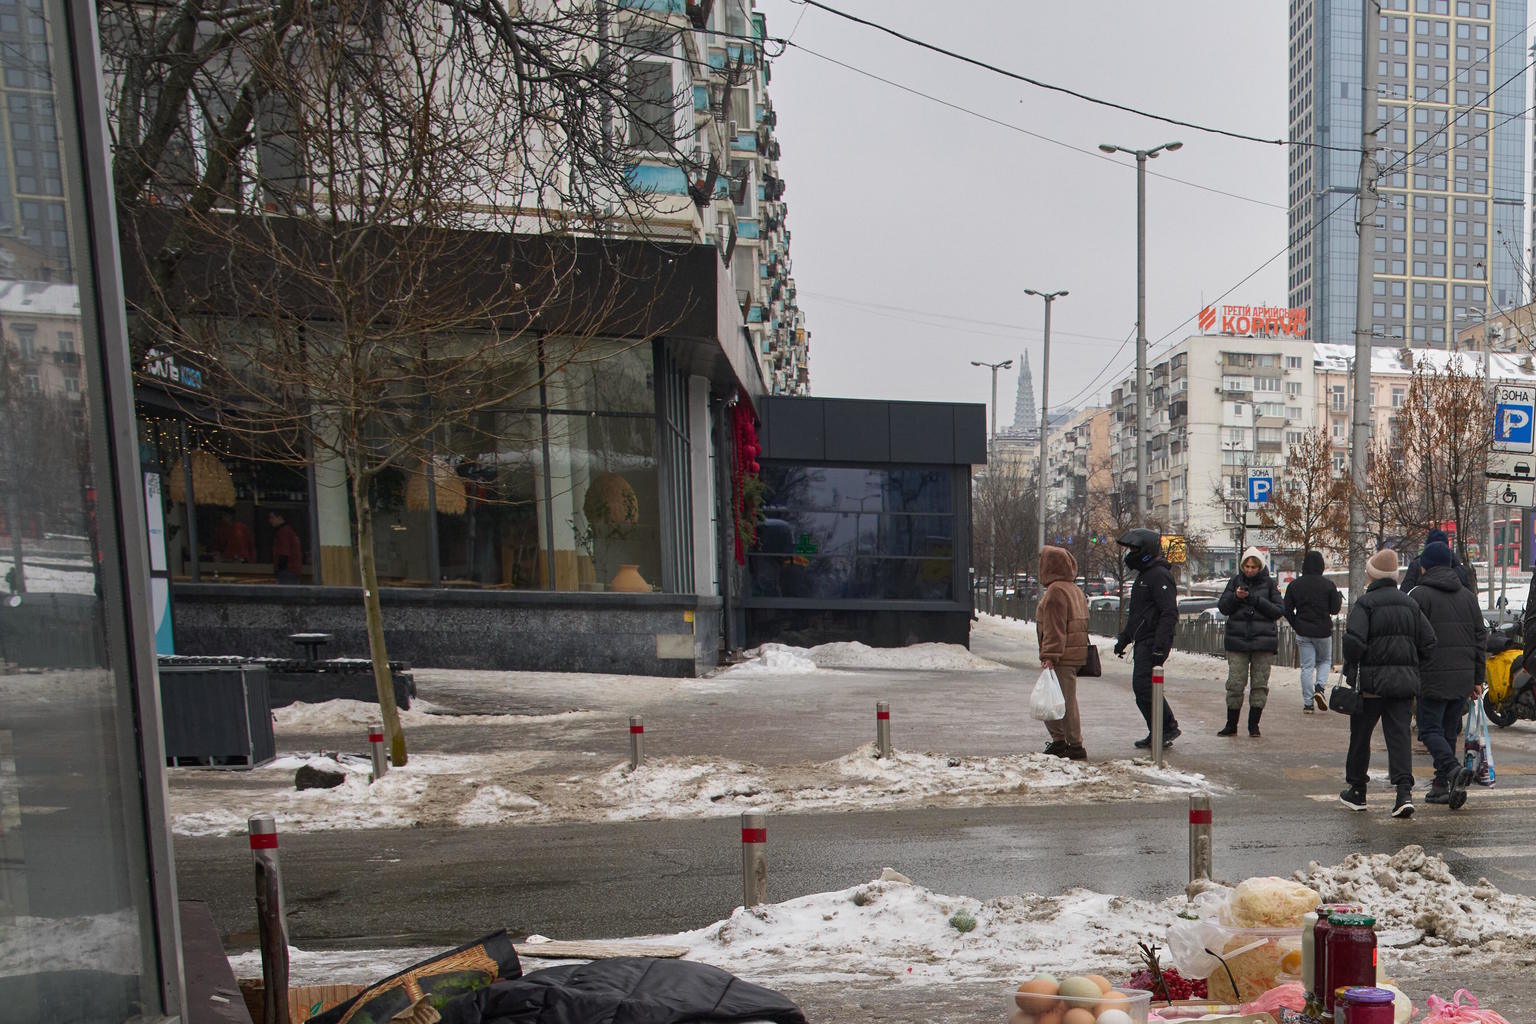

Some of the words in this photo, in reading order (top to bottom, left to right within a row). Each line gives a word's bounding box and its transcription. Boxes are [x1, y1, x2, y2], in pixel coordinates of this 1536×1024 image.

[1223, 304, 1251, 316] ТРЕТІЙ
[1222, 315, 1307, 336] КОРПУС
[1501, 389, 1529, 401] ЗОНА
[1251, 469, 1270, 477] ЗОНА
